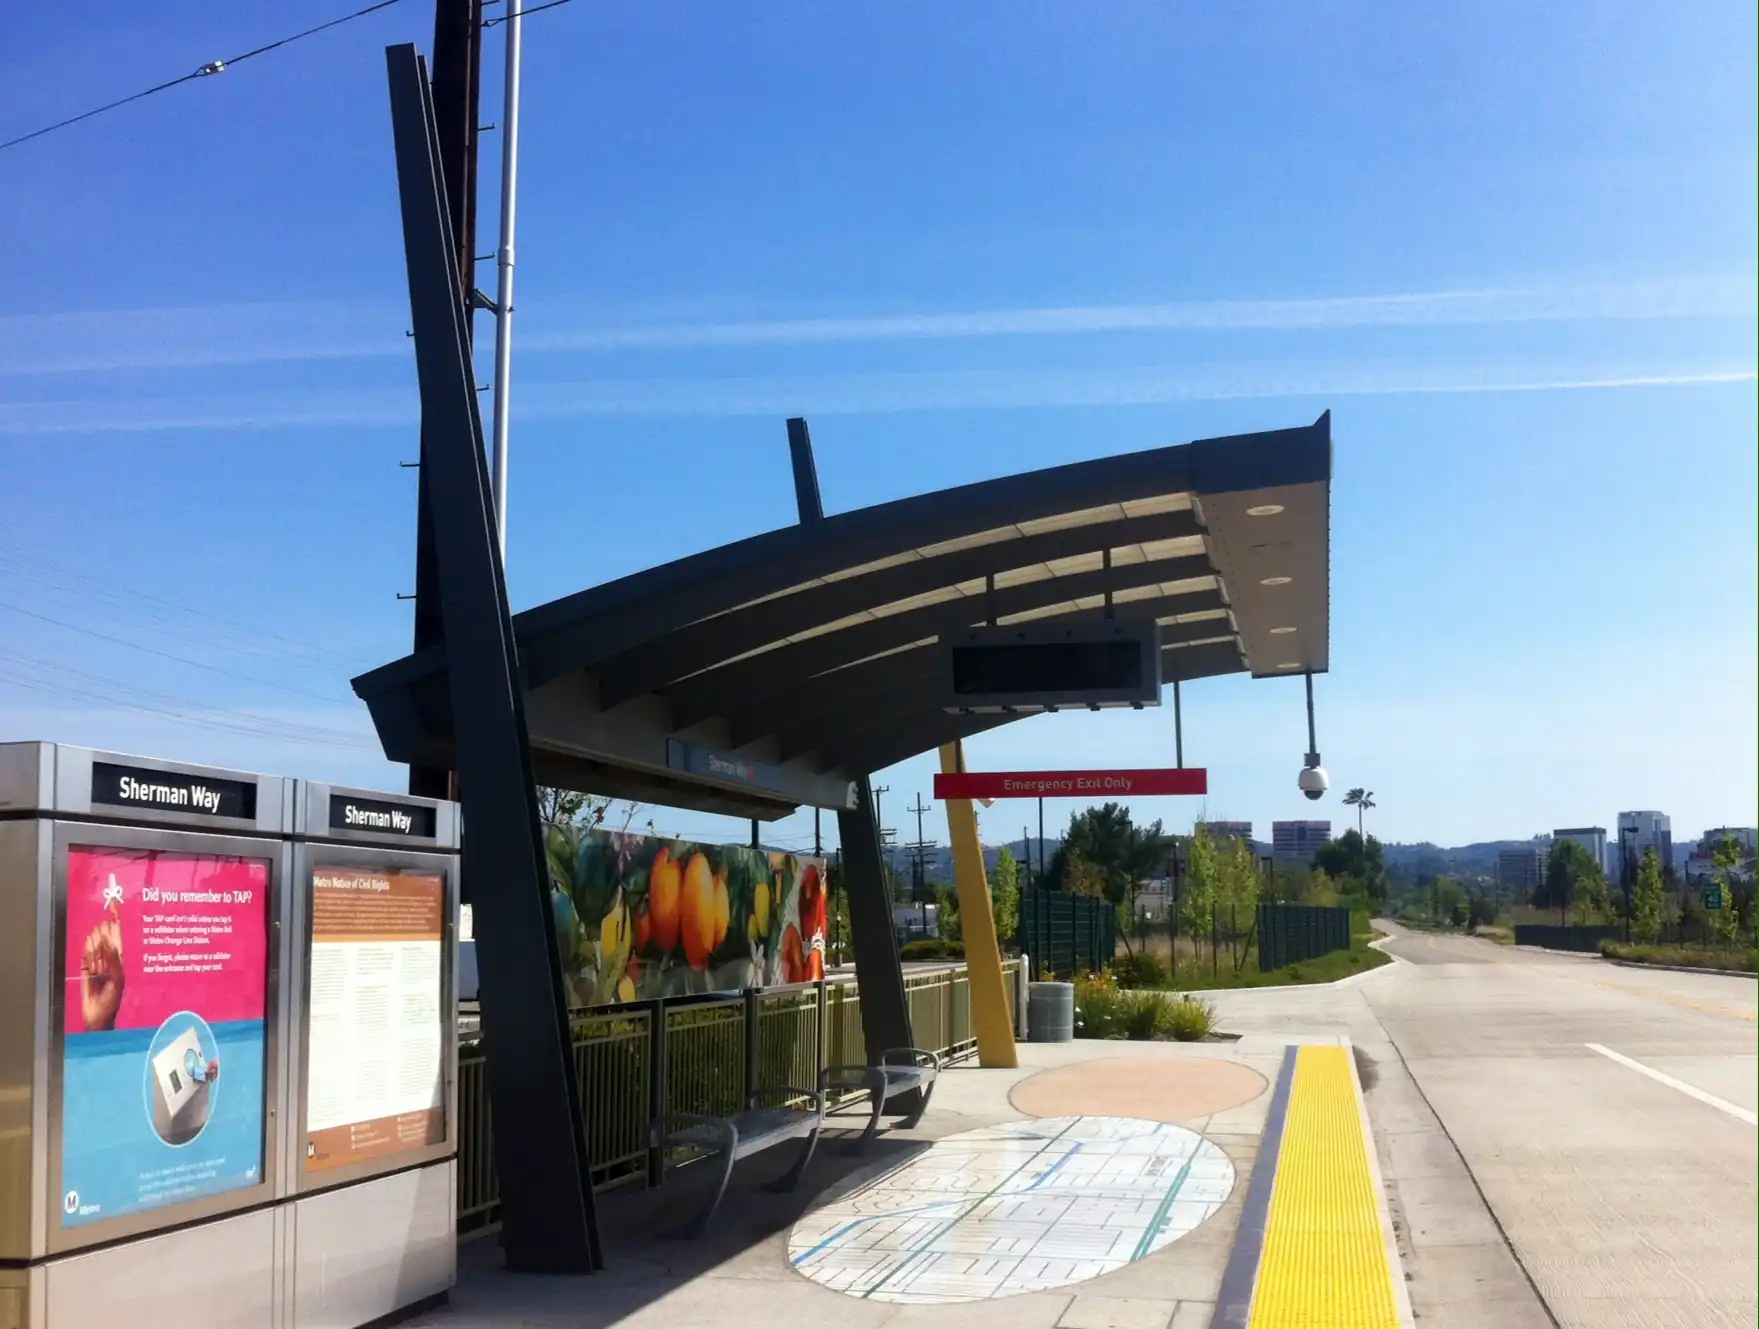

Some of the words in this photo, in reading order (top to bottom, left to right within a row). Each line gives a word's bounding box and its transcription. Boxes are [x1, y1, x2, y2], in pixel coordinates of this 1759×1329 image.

[1003, 779, 1073, 791] Emergency
[1077, 777, 1101, 789] Exit
[1104, 777, 1132, 790] Only
[119, 776, 188, 805] Sherman
[191, 785, 220, 813] Way
[345, 805, 390, 828] Sherman
[391, 810, 412, 834] Way
[313, 876, 331, 888] Metro
[332, 877, 351, 888] Notice
[351, 879, 358, 888] of
[358, 878, 371, 889] Civil
[371, 880, 390, 892] Rights
[142, 887, 159, 902] Did
[161, 891, 178, 906] you
[180, 888, 222, 903] remember
[223, 891, 232, 903] to
[233, 890, 253, 904] TAP?
[79, 1204, 100, 1216] Metro
